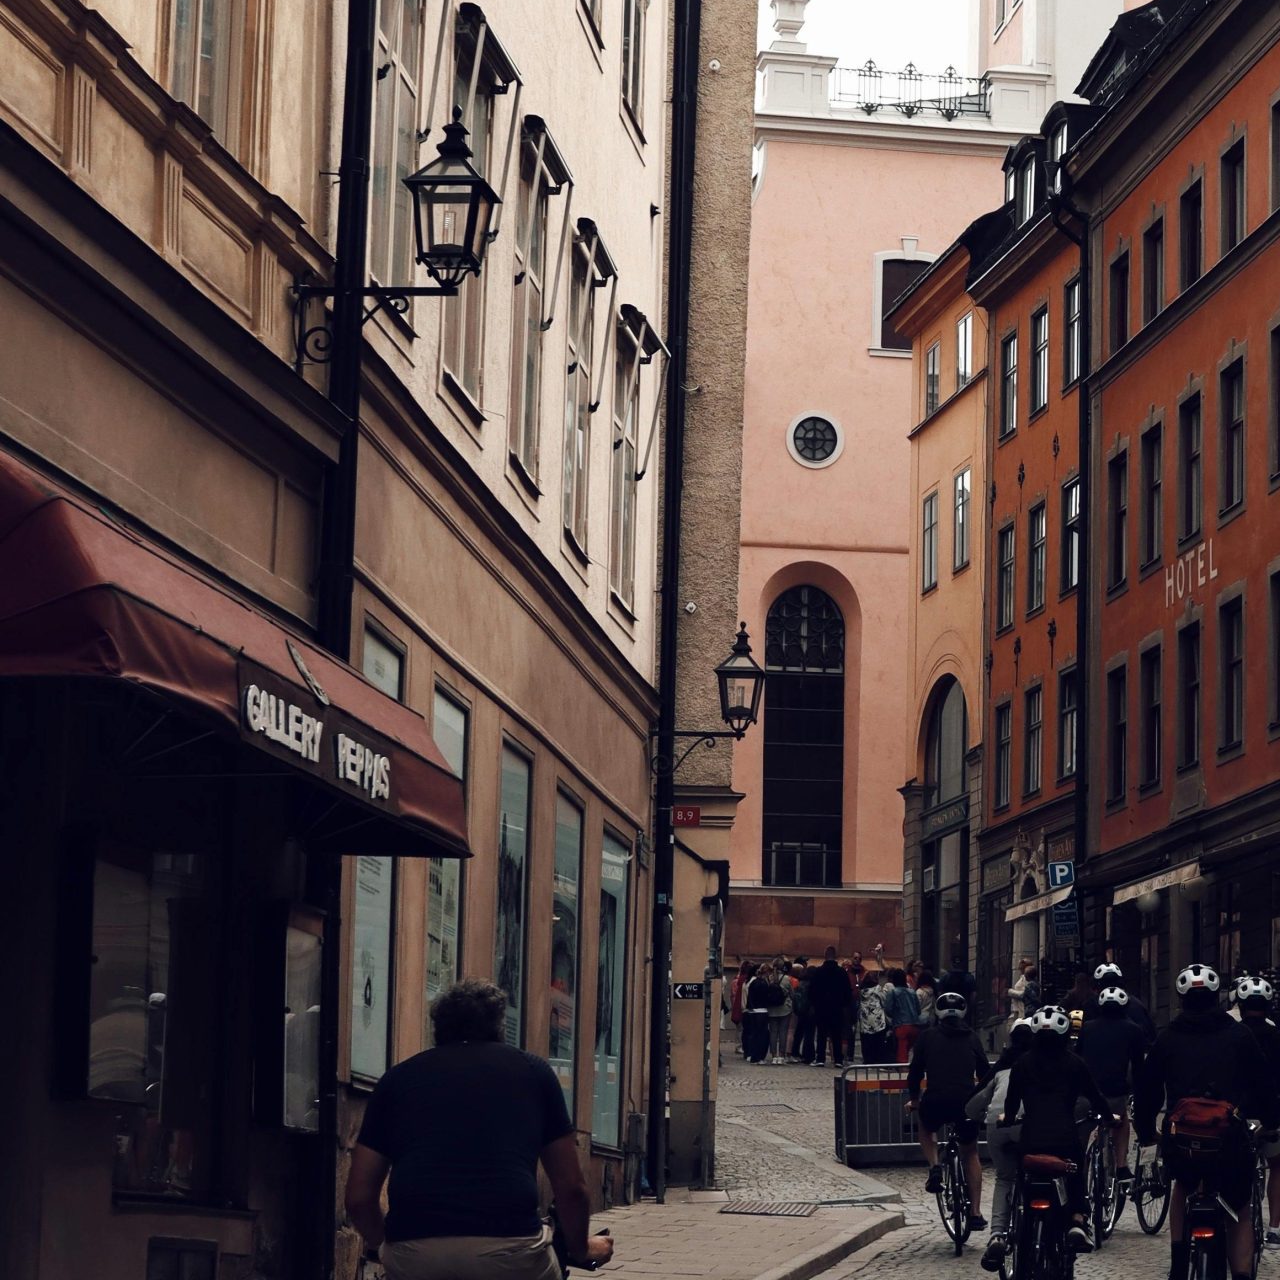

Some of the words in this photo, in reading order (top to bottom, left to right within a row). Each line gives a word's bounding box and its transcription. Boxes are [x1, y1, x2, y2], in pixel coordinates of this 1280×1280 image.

[1165, 537, 1218, 608] HOTEL
[246, 684, 324, 763] GALLERY
[337, 733, 391, 800] PEPPAS
[676, 810, 694, 821] 8,9
[1055, 864, 1069, 884] P
